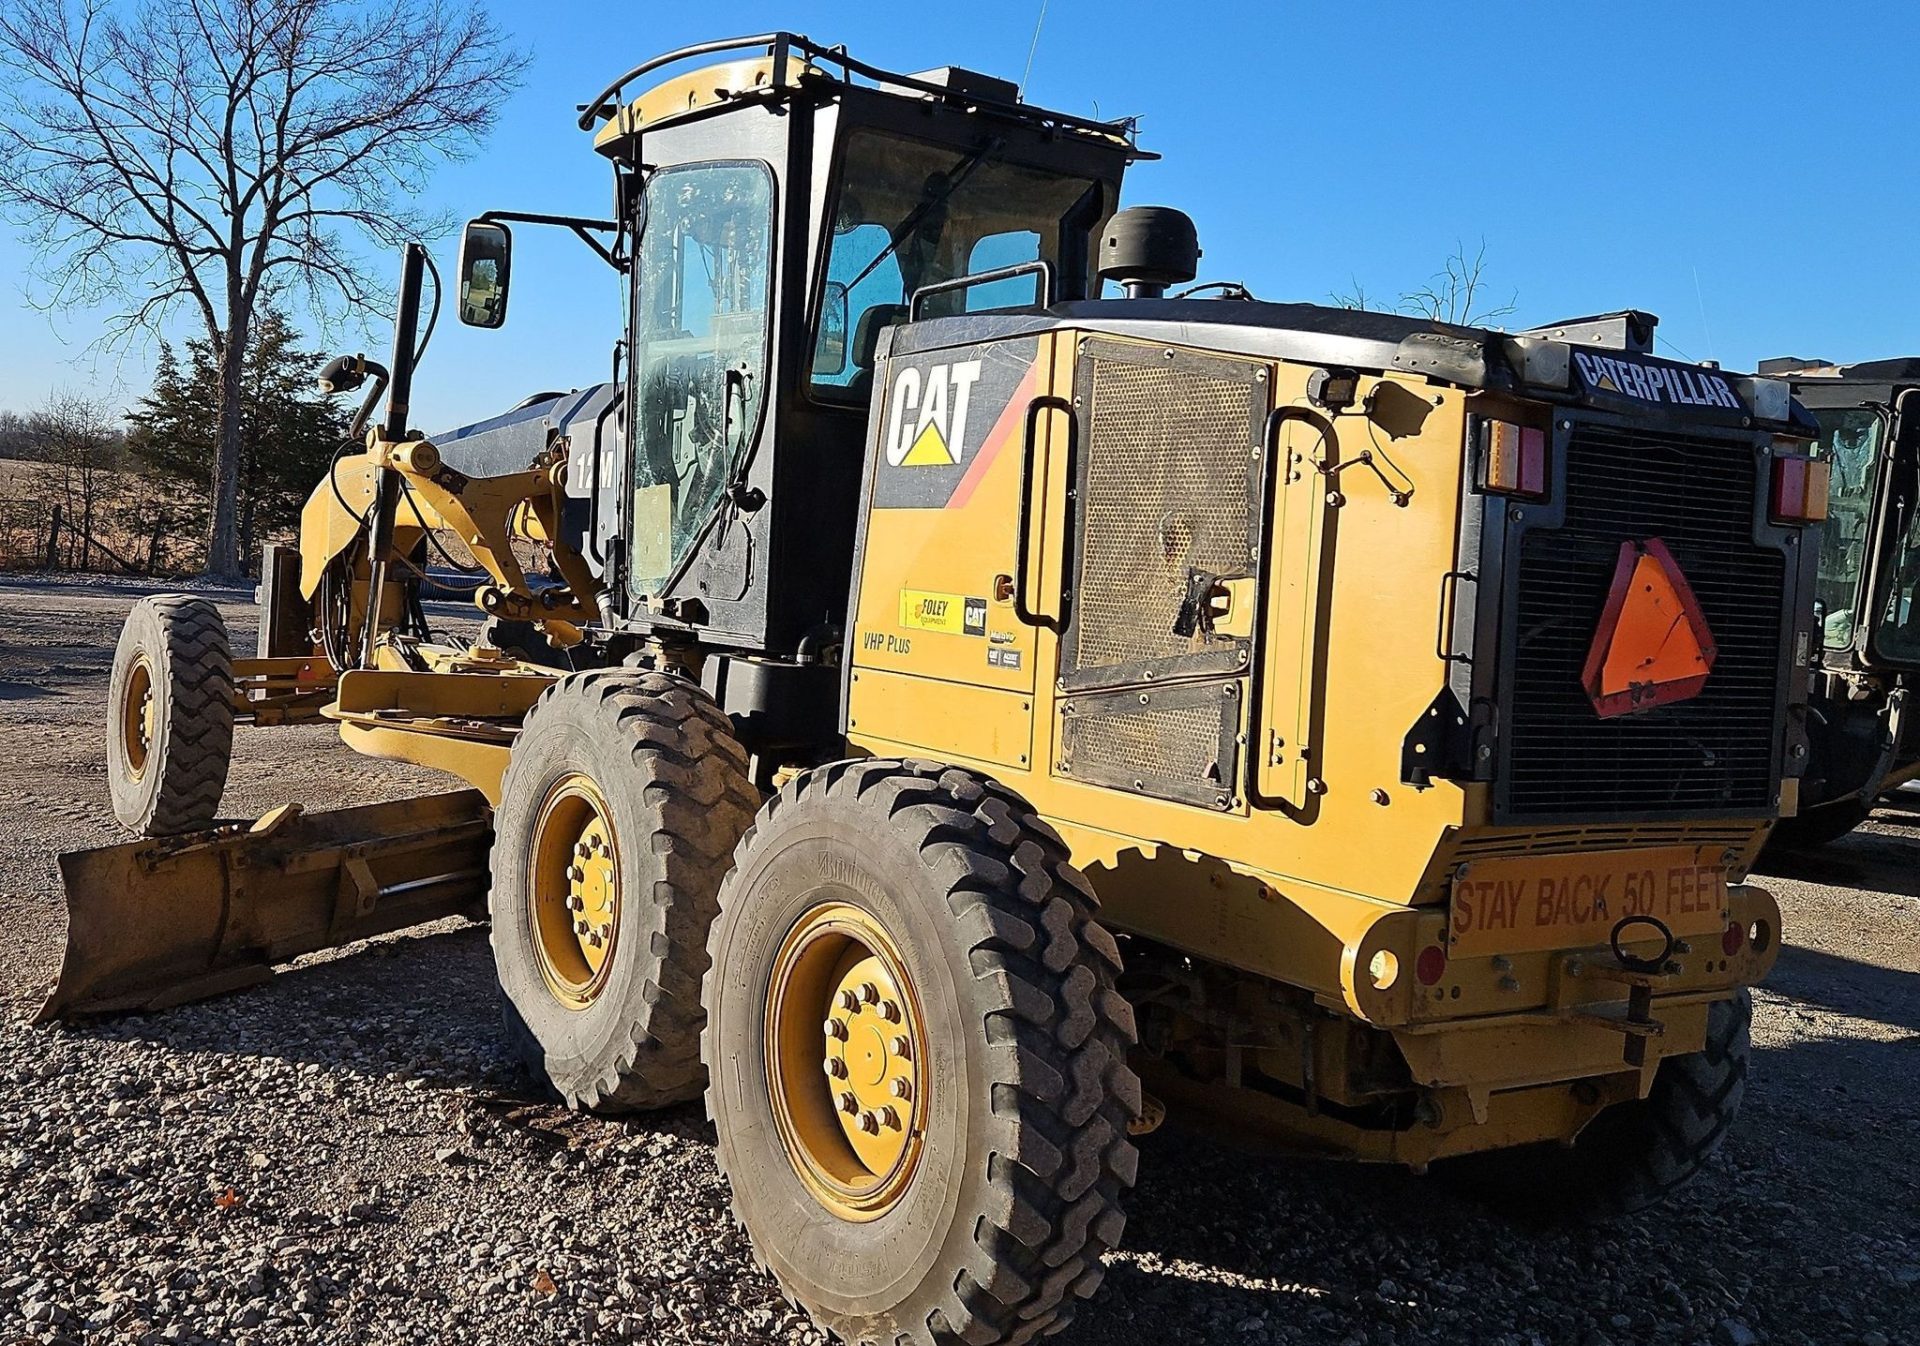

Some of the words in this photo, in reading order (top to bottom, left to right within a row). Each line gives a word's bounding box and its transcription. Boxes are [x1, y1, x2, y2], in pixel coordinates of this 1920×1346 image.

[1574, 352, 1740, 409] CATERPILLAR
[886, 360, 982, 467] CAT
[921, 598, 949, 616] FOLEY
[965, 606, 986, 628] CAT
[864, 632, 885, 651] VHP
[1452, 879, 1528, 934] STAY
[1535, 873, 1613, 927] BACK
[1622, 869, 1656, 917] 50
[1666, 865, 1728, 914] FEET
